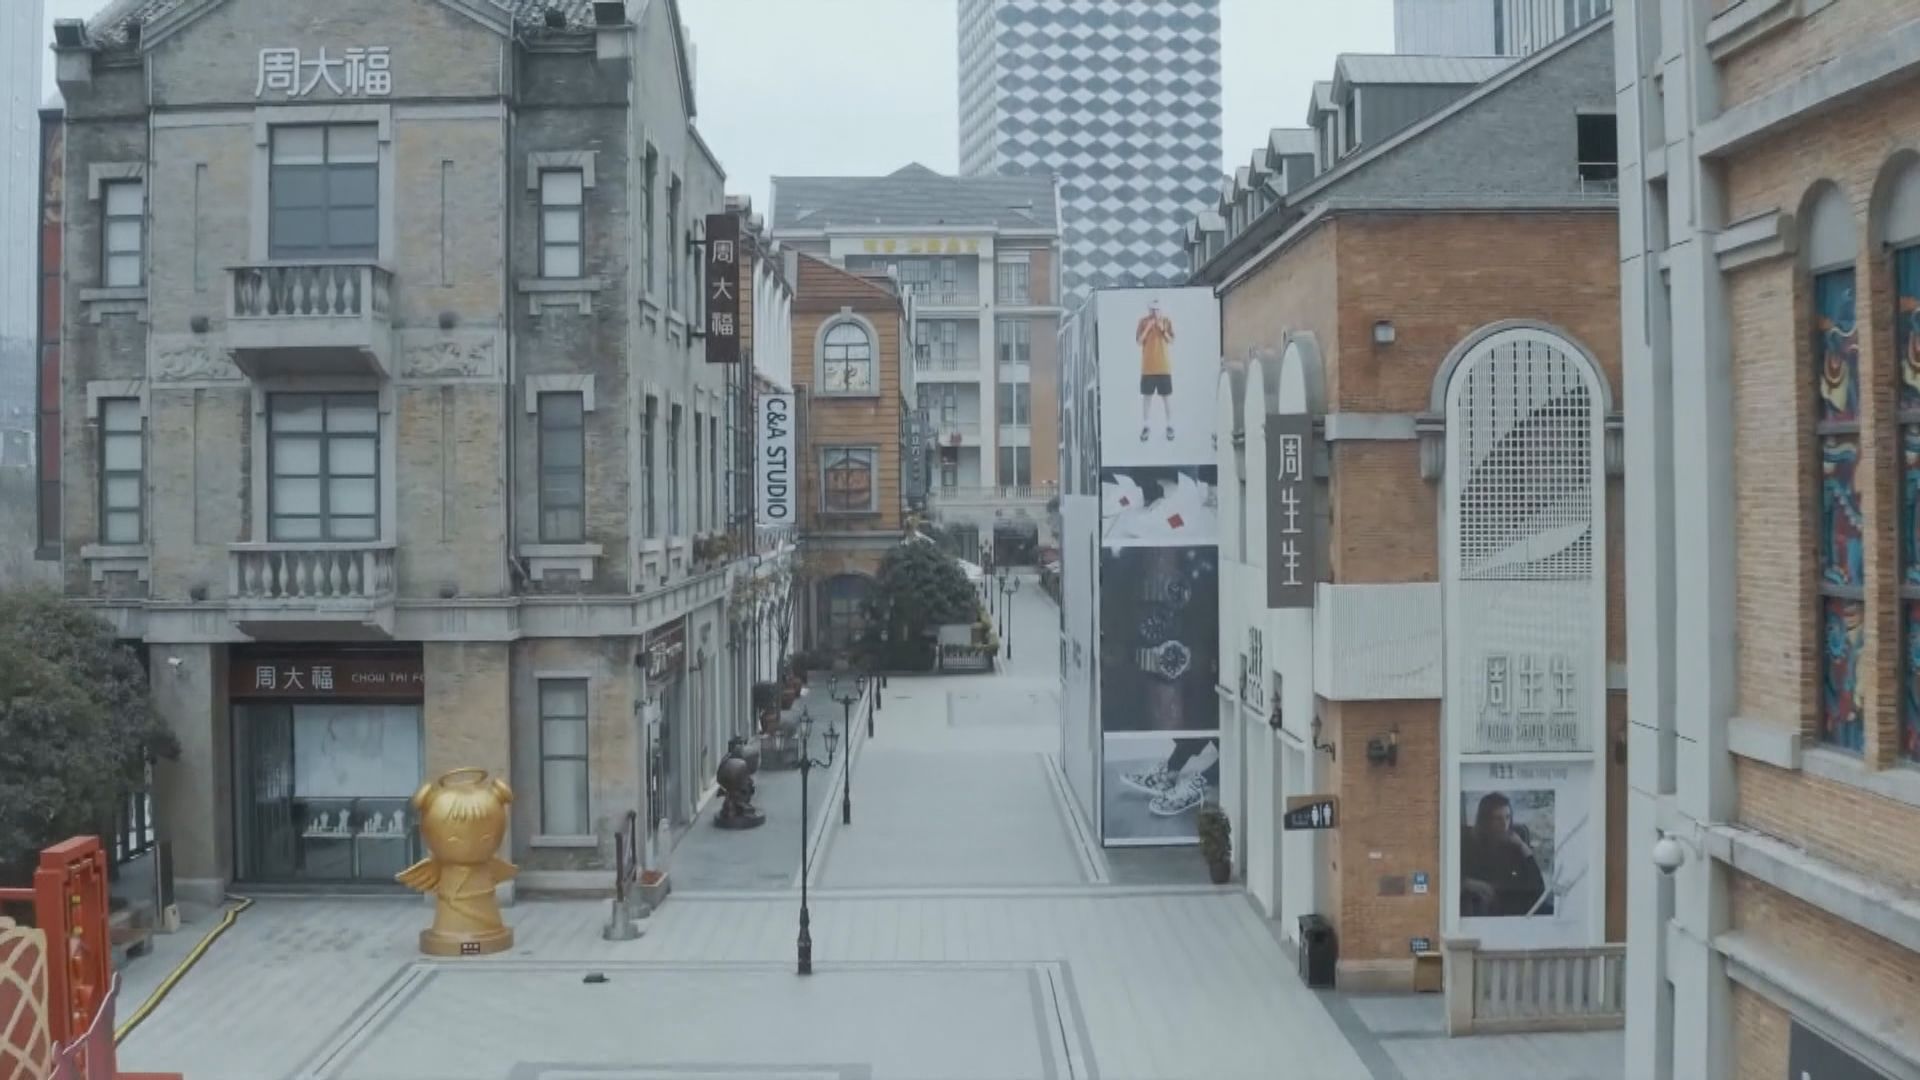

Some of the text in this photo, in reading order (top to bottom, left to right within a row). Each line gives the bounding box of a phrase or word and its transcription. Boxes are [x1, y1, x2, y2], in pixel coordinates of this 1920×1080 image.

[255, 46, 391, 97] 周大福
[711, 239, 734, 337] 周大福
[766, 399, 788, 520] C&A STUDIO
[1278, 434, 1303, 586] 周生生
[255, 665, 334, 690] 周大福
[351, 672, 386, 684] CHOW
[390, 672, 408, 684] TAI
[1480, 653, 1578, 716] 周生生
